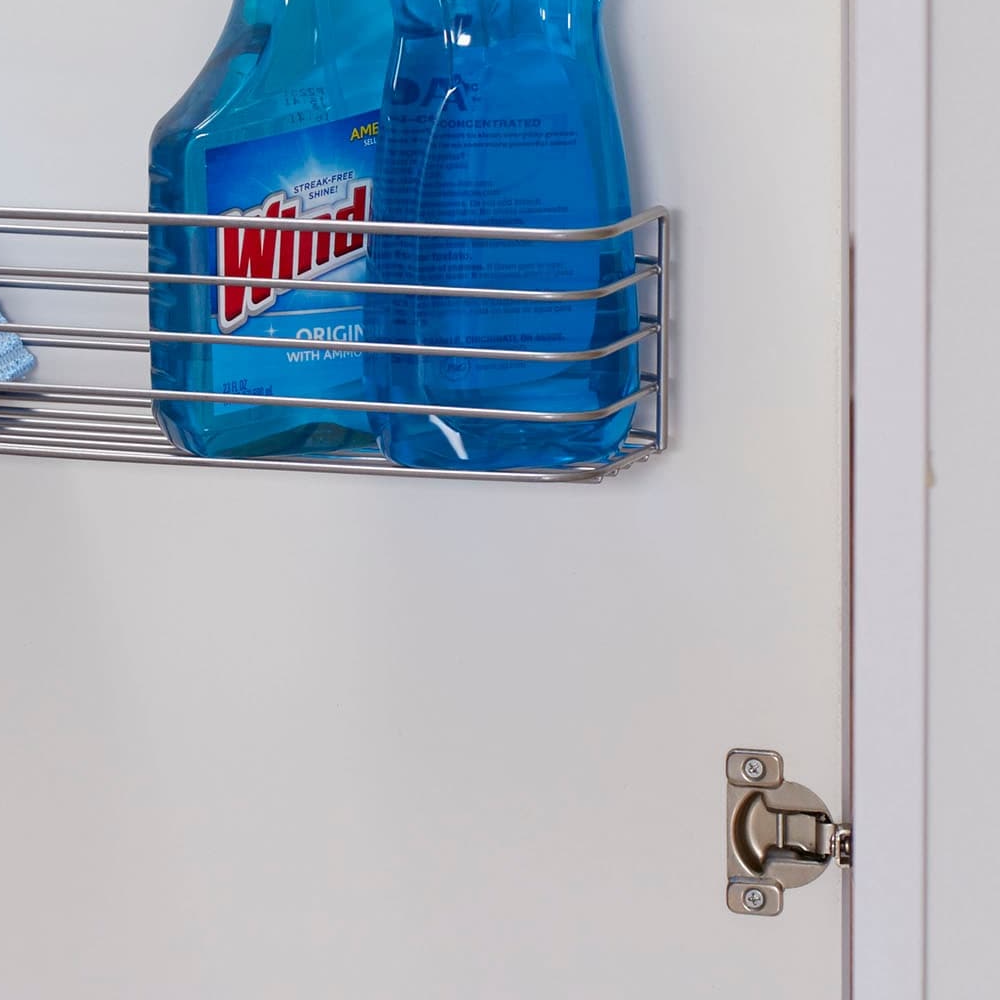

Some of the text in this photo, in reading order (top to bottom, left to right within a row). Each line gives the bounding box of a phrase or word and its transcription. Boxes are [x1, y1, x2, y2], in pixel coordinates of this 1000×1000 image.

[350, 121, 379, 141] AME
[293, 170, 354, 194] STREAK-FREE
[308, 185, 339, 200] SHINE!
[286, 350, 320, 363] WITH
